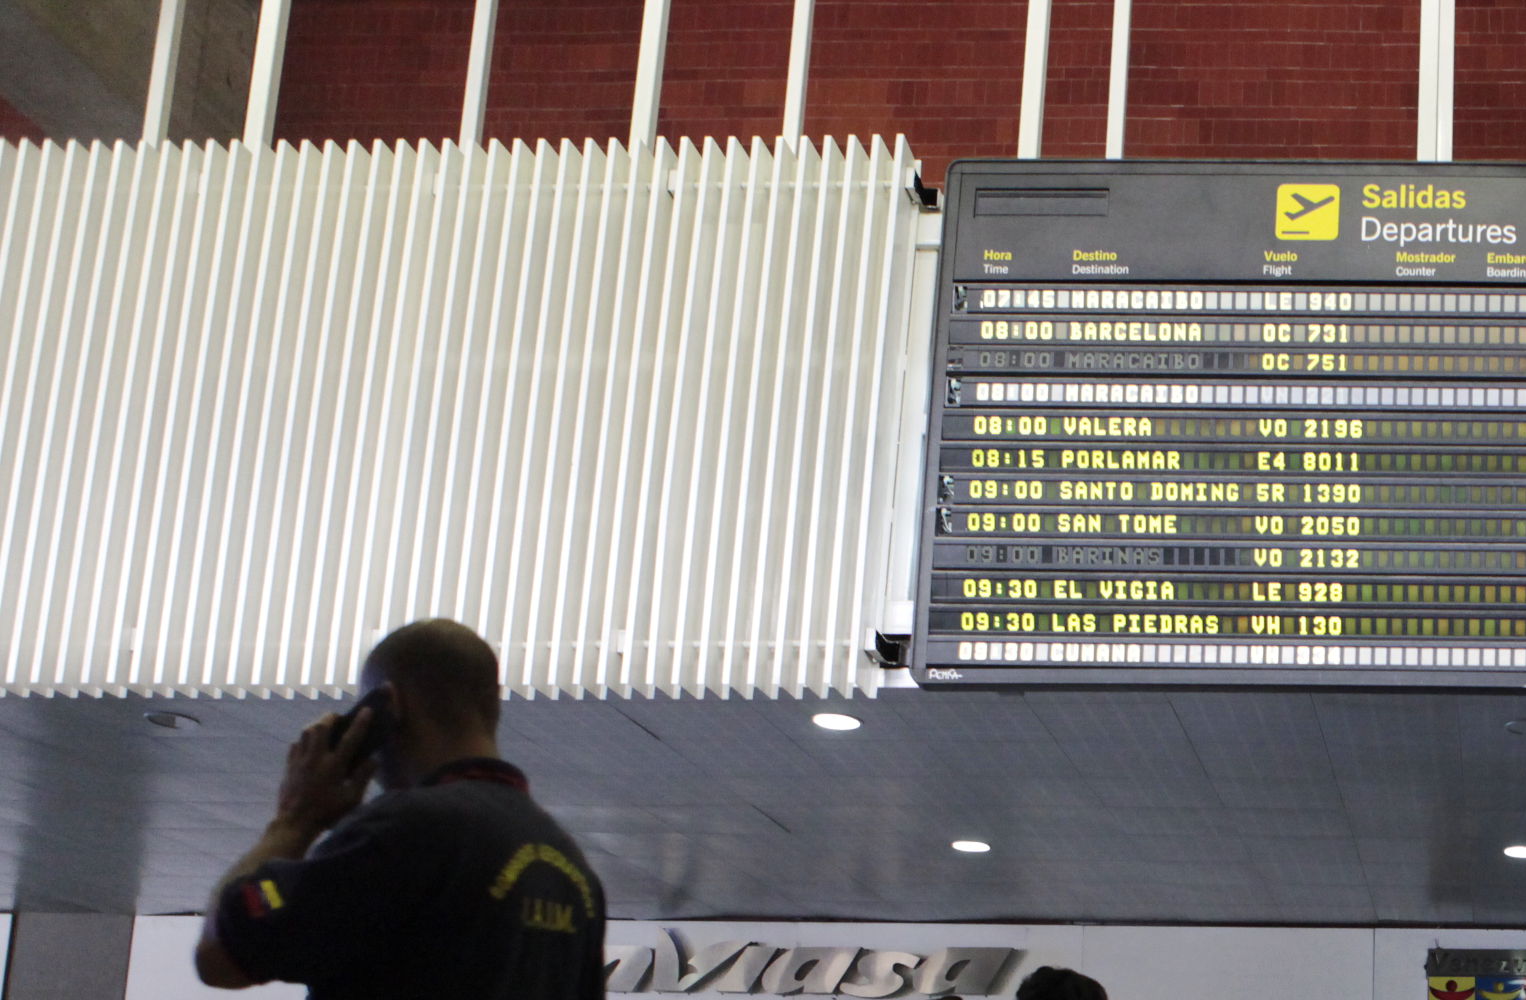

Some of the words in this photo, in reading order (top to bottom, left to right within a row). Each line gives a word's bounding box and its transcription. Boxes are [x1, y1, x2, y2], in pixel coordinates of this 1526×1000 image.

[1361, 183, 1467, 209] Salidas
[1360, 216, 1518, 247] Departures
[983, 249, 1012, 261] Hora
[1072, 249, 1118, 262] Destino
[1263, 250, 1298, 262] Vuelo
[1395, 251, 1457, 264] Mostrador
[983, 264, 1009, 275] Time
[1071, 264, 1130, 276] Destination
[1263, 264, 1293, 277] Flight
[1395, 266, 1437, 278] Counter
[983, 290, 1055, 309] 07:45
[1071, 290, 1203, 310] MARACAIBO
[1264, 292, 1292, 311] LE
[1309, 292, 1352, 311] 940
[980, 321, 1053, 340] 08:00
[1069, 321, 1202, 342] BARCELONA
[1262, 323, 1291, 343] OC
[1308, 323, 1348, 343] 731
[979, 352, 1051, 368] 08:00
[1068, 352, 1201, 369] MARACAIBO
[1261, 353, 1290, 371] OC
[1306, 354, 1347, 371] 751
[1064, 383, 1199, 404] MARACAIBO
[973, 416, 1047, 435] 08:00
[1063, 417, 1152, 436] VALERA
[1258, 418, 1287, 438] VO
[1304, 419, 1363, 439] 2196
[971, 449, 1045, 468] 08:15
[1061, 450, 1180, 470] PORLAMAR
[1257, 451, 1286, 471] E4
[1303, 452, 1359, 472] 8011
[969, 480, 1042, 499] 09:00
[1059, 481, 1133, 500] SANTO
[1151, 482, 1239, 502] DOMING
[1303, 484, 1361, 503] 1390
[967, 512, 1041, 532] 09:00
[1057, 513, 1101, 533] SAN
[1119, 514, 1177, 534] TOME
[1254, 515, 1283, 535] VO
[1301, 516, 1360, 535] 2050
[966, 545, 1039, 563] 09:00
[1057, 546, 1161, 564] BARINAS
[1253, 548, 1282, 567] VO
[1300, 548, 1359, 568] 2132
[963, 579, 1037, 598] 09:30
[1053, 579, 1082, 599] EL
[1099, 580, 1174, 600] VIGIA
[1252, 581, 1281, 602] LE
[1299, 582, 1343, 602] 928
[961, 612, 1035, 631] 09:30
[1051, 612, 1096, 632] LAS
[1113, 613, 1219, 634] PIEDRAS
[1251, 615, 1281, 635] VH
[1299, 615, 1342, 636] 130
